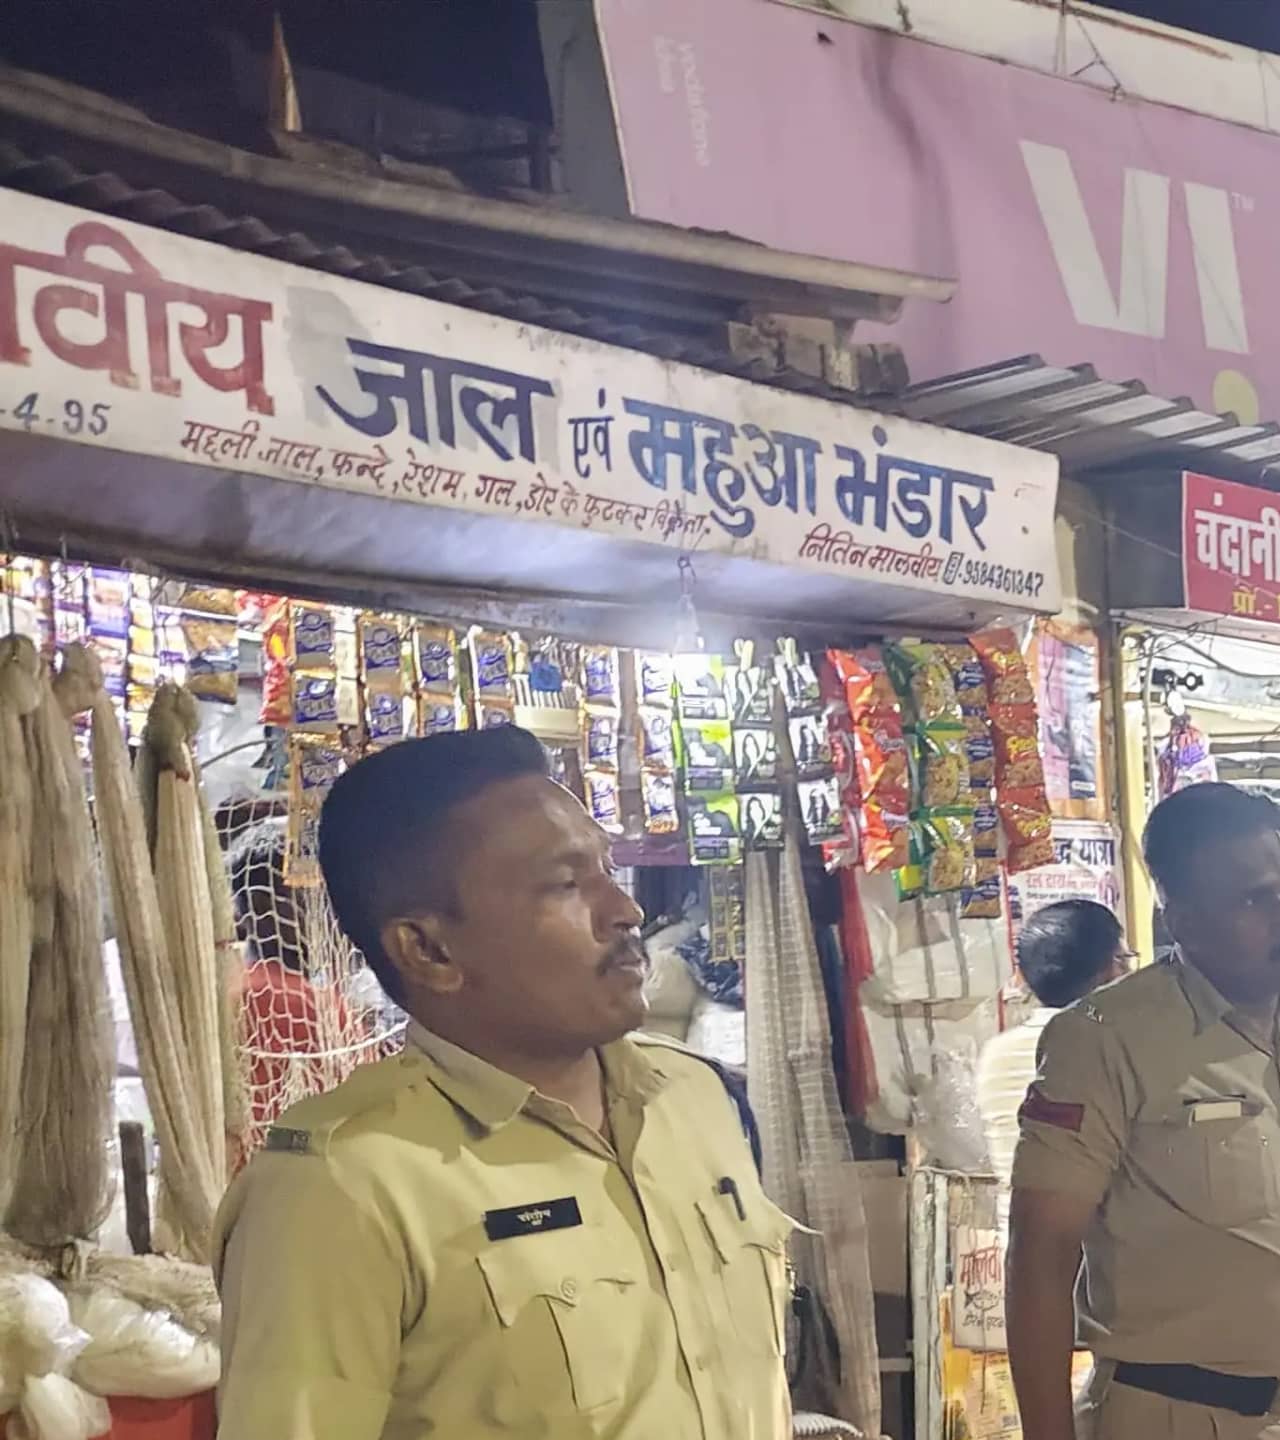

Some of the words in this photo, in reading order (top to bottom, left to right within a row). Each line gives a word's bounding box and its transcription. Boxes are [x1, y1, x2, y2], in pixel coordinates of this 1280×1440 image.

[316, 338, 555, 464] जाल
[569, 388, 615, 479] एवं
[622, 397, 822, 538] महुआ
[835, 425, 995, 551] भंडार
[799, 522, 869, 568] नितिन
[867, 541, 944, 582] मालवीय
